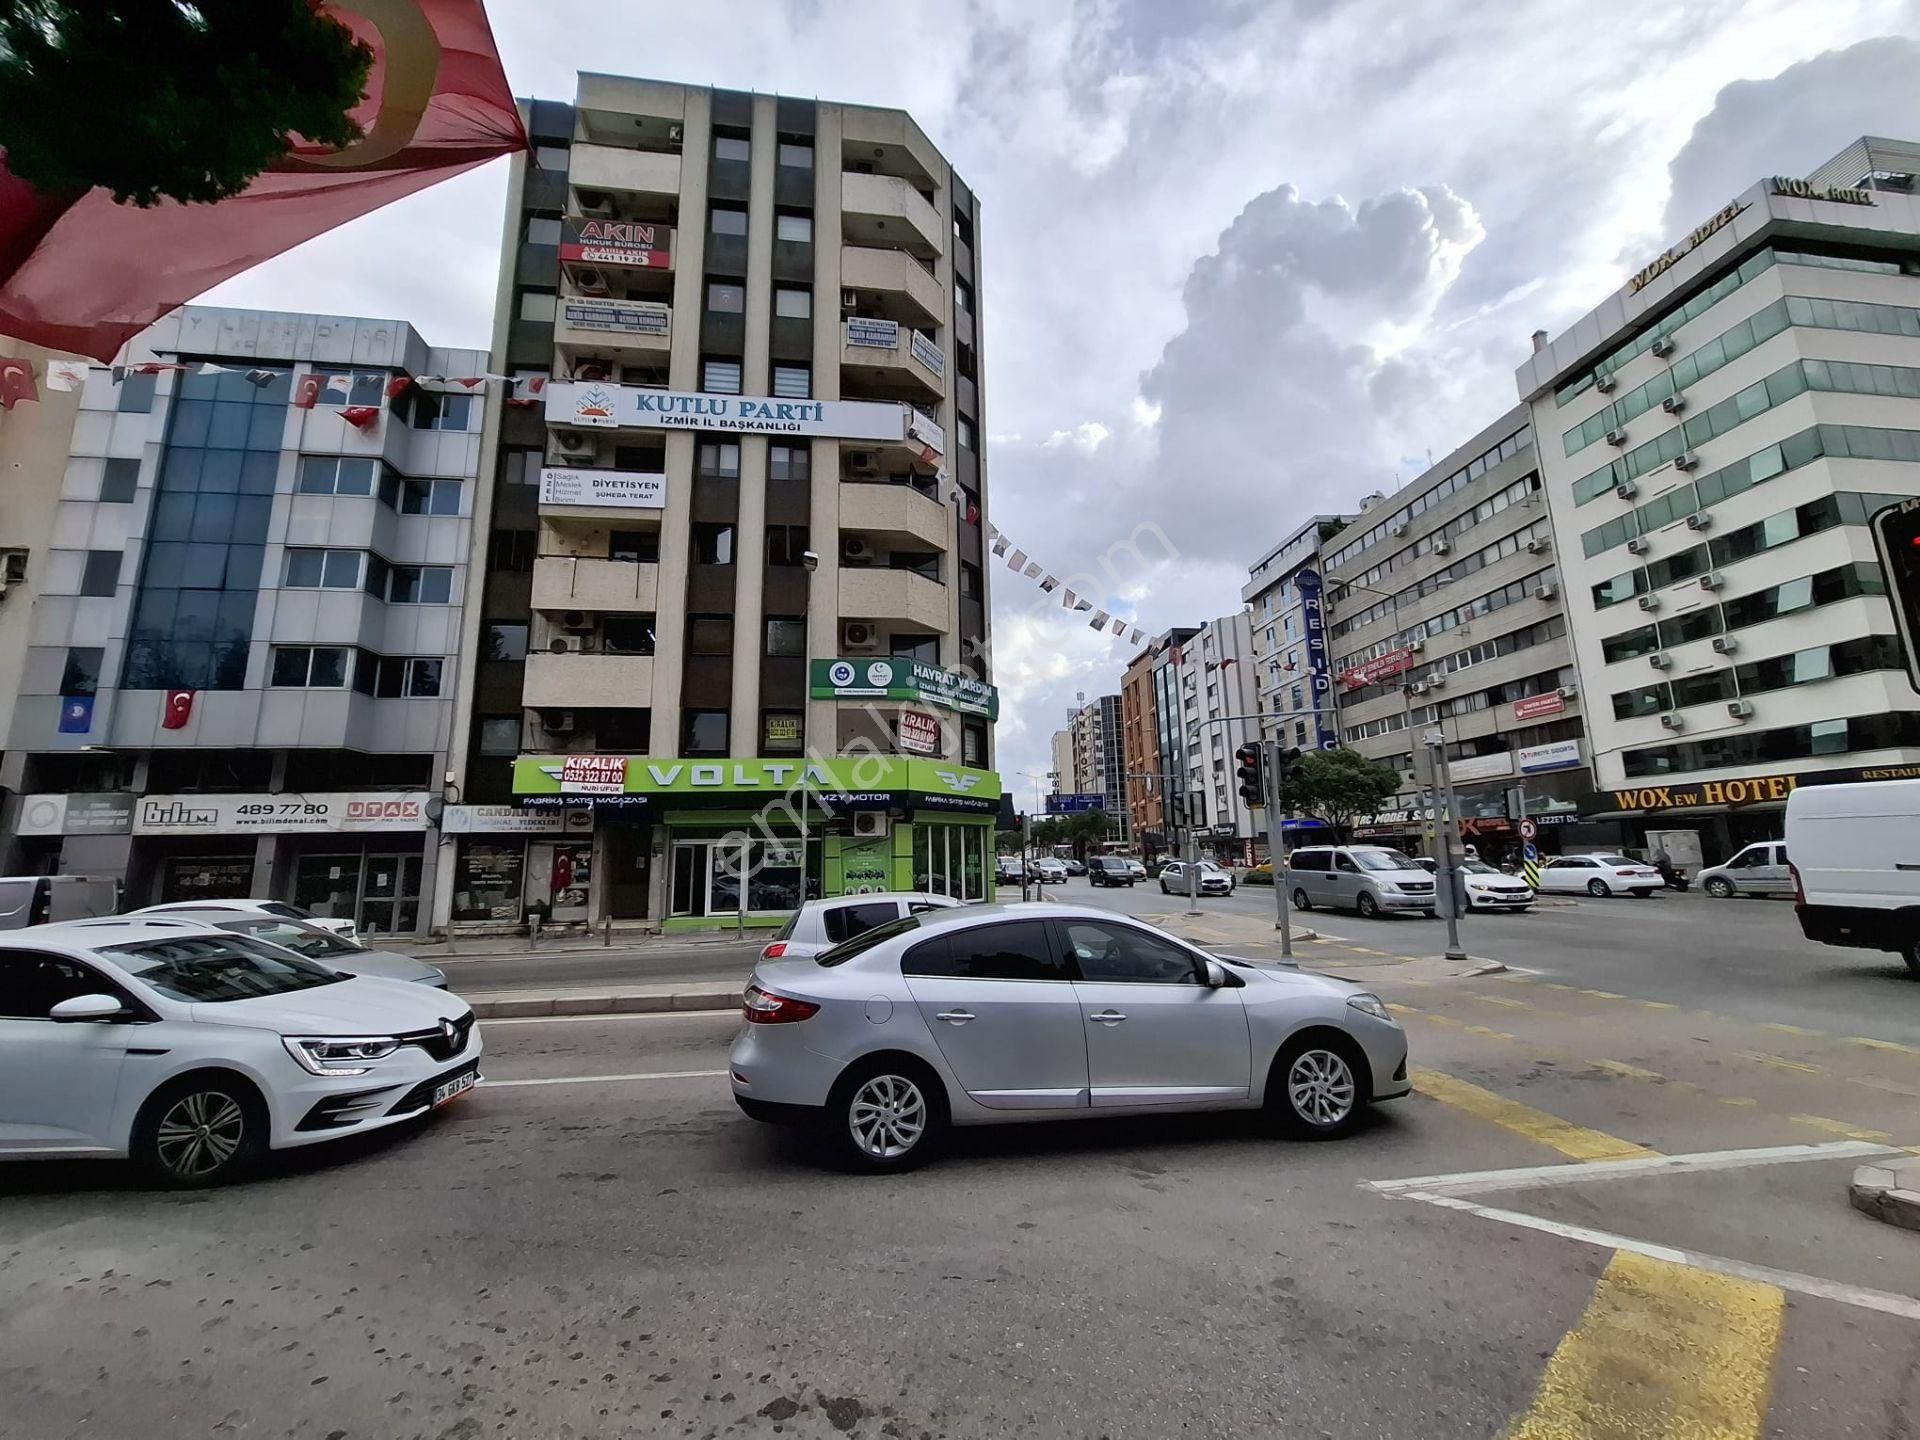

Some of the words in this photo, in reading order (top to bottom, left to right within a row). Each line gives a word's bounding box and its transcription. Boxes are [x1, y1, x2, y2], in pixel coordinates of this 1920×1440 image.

[580, 221, 654, 243] AKIN
[580, 239, 612, 247] HUKUK
[636, 394, 727, 416] KUTLU
[739, 401, 823, 422] PARTİ
[660, 414, 699, 426] İZMİR
[703, 416, 715, 427] İL
[719, 419, 801, 431] BAŞKANLIĞI
[592, 479, 659, 490] DİYETİSYEN
[913, 664, 954, 686] HAYRAT
[564, 770, 583, 781] 0532
[585, 771, 599, 782] 322
[601, 771, 610, 782] 87
[611, 771, 623, 783] 00
[648, 764, 829, 785] VOLTA
[1862, 767, 1920, 780] RESTAU
[850, 793, 890, 801] MOTOR
[1615, 788, 1674, 810] WOX
[236, 804, 274, 815] 489
[279, 804, 301, 814] 77
[303, 803, 328, 815] 80
[348, 801, 419, 817] UTAX
[1374, 811, 1408, 824] MODEL
[1537, 815, 1565, 824] LEZZET
